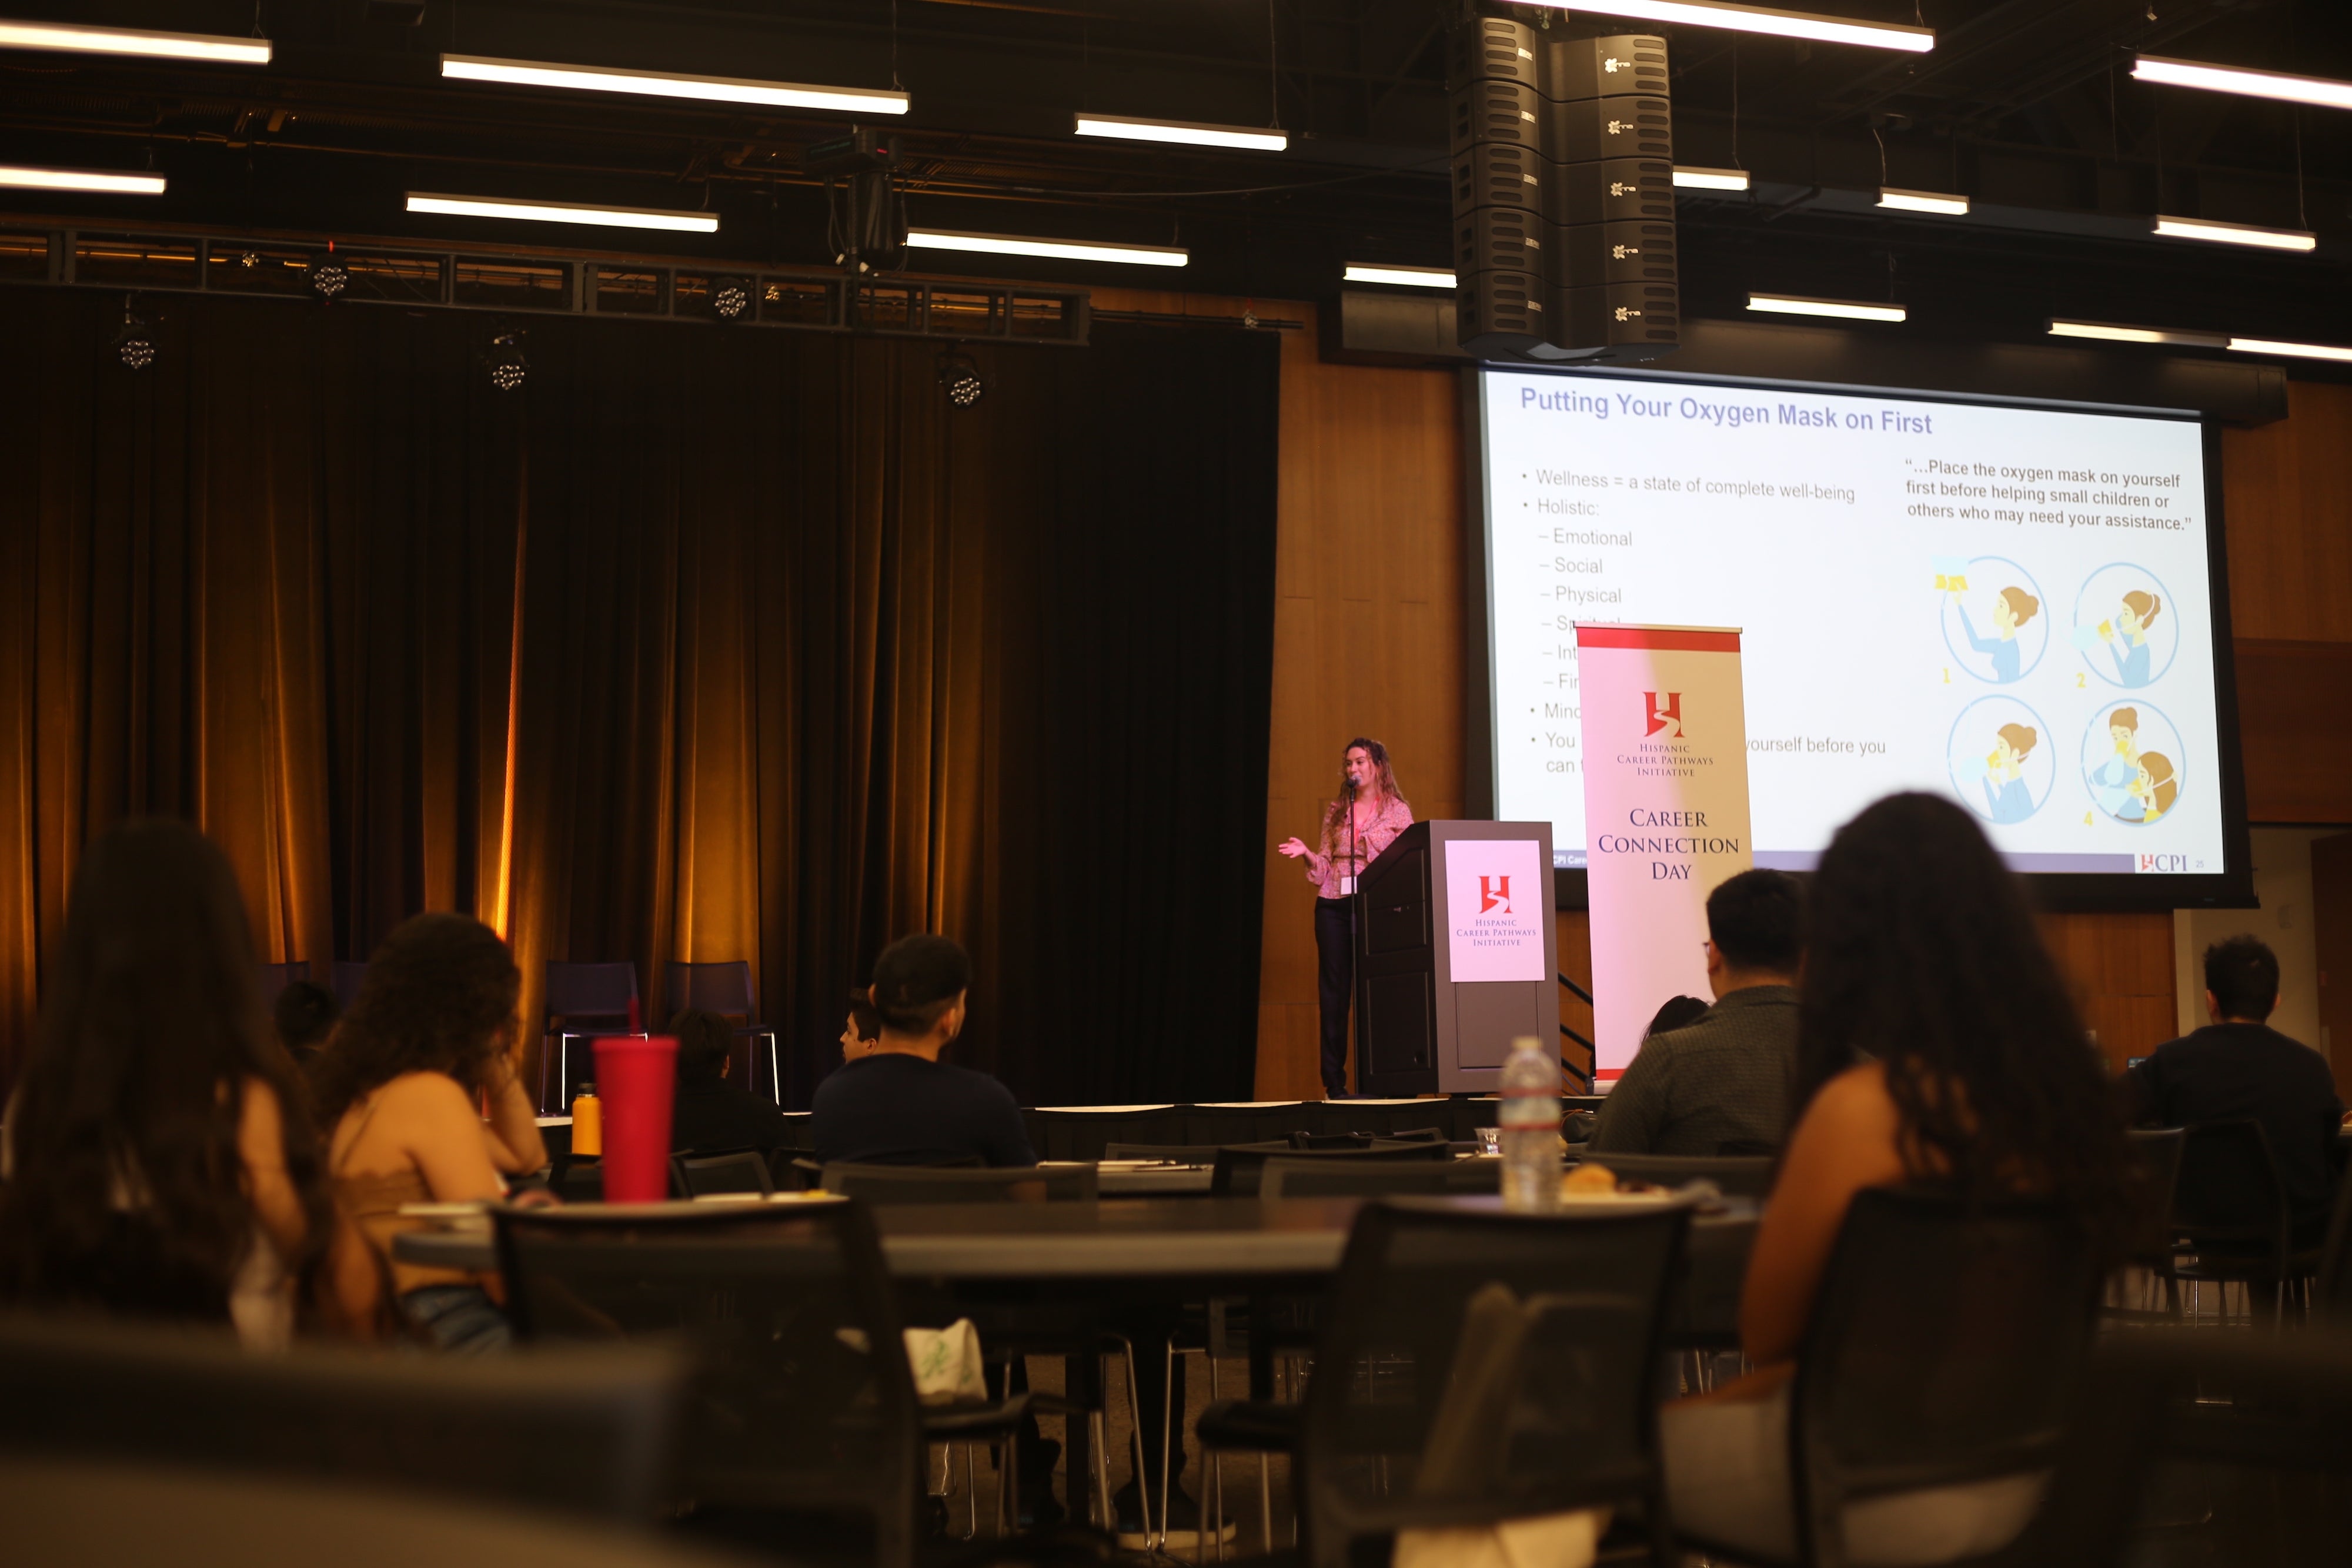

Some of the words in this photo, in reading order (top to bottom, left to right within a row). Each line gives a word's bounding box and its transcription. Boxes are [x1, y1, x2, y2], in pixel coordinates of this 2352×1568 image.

[1521, 387, 1608, 420] Putting
[1616, 393, 1672, 417] Your
[1680, 398, 1769, 427] Oxygen
[1778, 403, 1838, 428] Mask
[1845, 413, 1873, 430] on
[1882, 410, 1933, 434] First
[1973, 463, 1996, 477] the
[2000, 466, 2053, 483] oxygen
[2058, 469, 2096, 483] mask
[2100, 472, 2118, 484] on
[2123, 474, 2180, 488] yourself
[1536, 469, 1609, 488] Wellness
[1629, 477, 1638, 489] a
[1643, 476, 1681, 492] state
[1686, 477, 1702, 492] of
[1706, 480, 1775, 499] complete
[1780, 483, 1855, 504] well-being
[1906, 480, 1936, 494] first
[1940, 482, 1987, 497] before
[1992, 484, 2045, 504] helping
[2050, 490, 2088, 504] small
[2093, 491, 2150, 507] children
[2154, 496, 2170, 508] or
[1538, 498, 1600, 516] Holistic:
[1907, 503, 1955, 519] others
[1959, 506, 1990, 520] who
[1994, 509, 2024, 525] may
[2029, 510, 2063, 524] need
[2068, 513, 2101, 528] your
[1553, 527, 1633, 546] Emotional
[1555, 556, 1603, 574] Social
[1555, 585, 1622, 606] Physical
[1558, 644, 1578, 660] Int
[1943, 668, 1951, 684] 1
[2076, 672, 2086, 688] 2
[1545, 732, 1575, 748] You
[1640, 743, 1690, 753] HISPANIC
[1807, 737, 1855, 754] before
[1860, 741, 1886, 758] you
[1546, 760, 1575, 773] can
[1617, 755, 1657, 765] CAREER
[1661, 755, 1713, 765] PATHWAYS
[1638, 767, 1695, 777] INITIATIVE
[1629, 808, 1709, 827] CAREER
[2084, 811, 2093, 827] 4
[1598, 834, 1739, 854] CONNECTION
[1553, 855, 1566, 864] CPI
[1568, 855, 1586, 865] Care
[2196, 860, 2204, 868] 25
[1651, 861, 1692, 880] DAY
